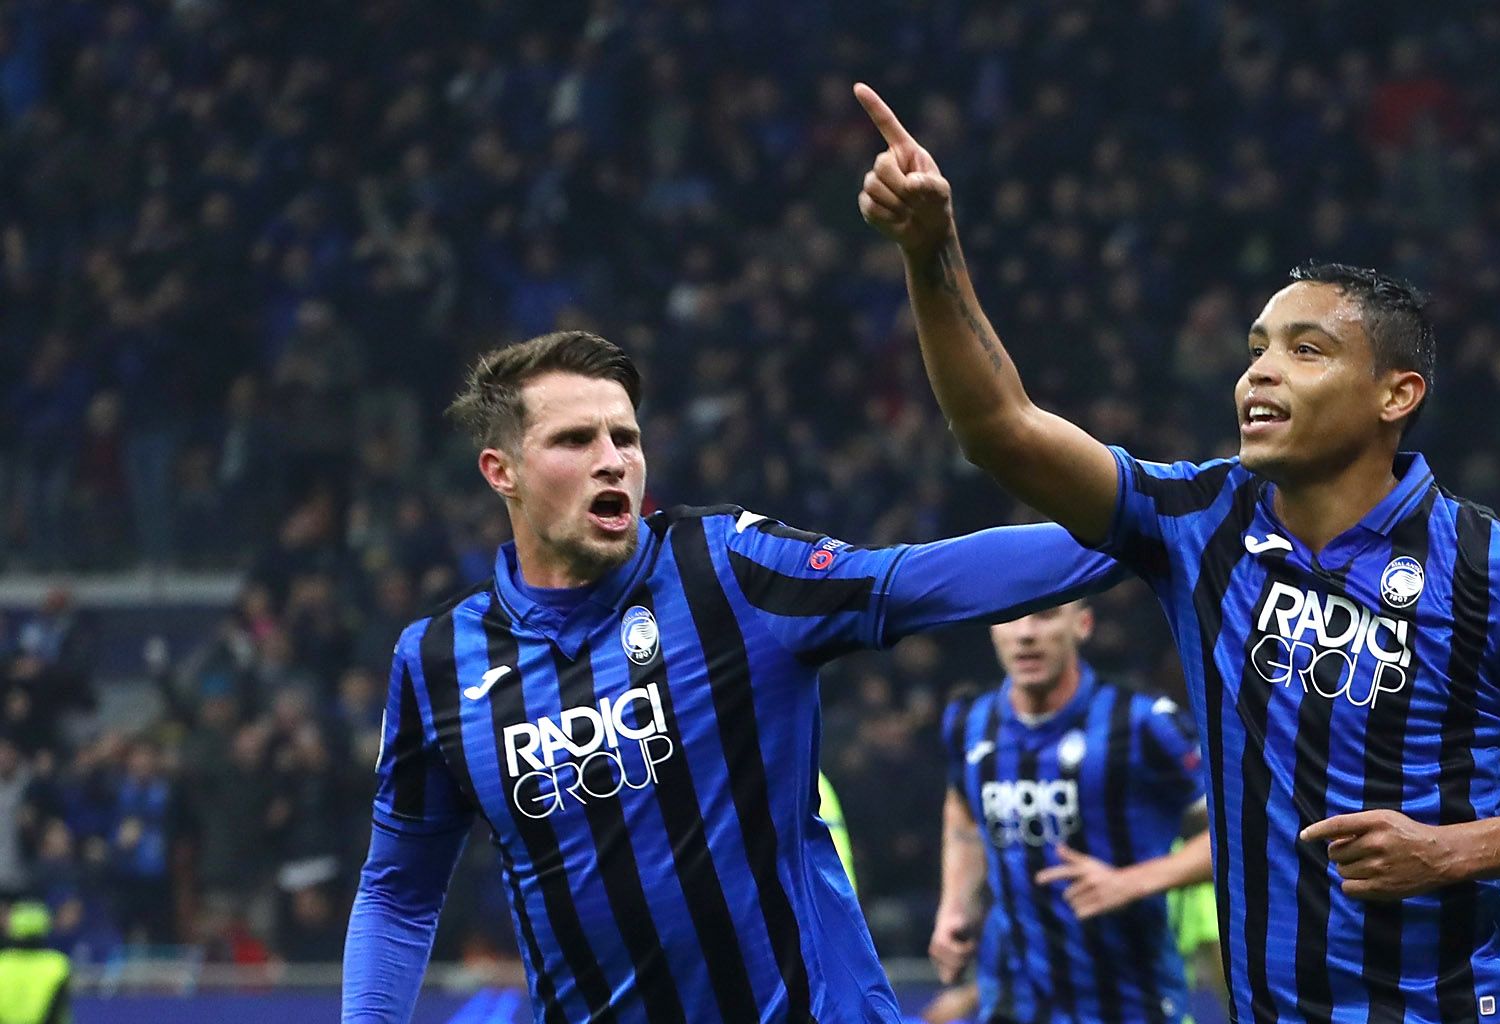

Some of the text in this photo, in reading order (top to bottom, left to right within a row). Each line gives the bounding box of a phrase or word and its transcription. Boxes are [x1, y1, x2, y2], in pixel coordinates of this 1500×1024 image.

[1257, 581, 1412, 668] RADICI
[1251, 634, 1406, 709] GROUP
[503, 682, 668, 777] RADICI
[513, 735, 674, 818] GROUP
[981, 779, 1079, 820] RADICI
